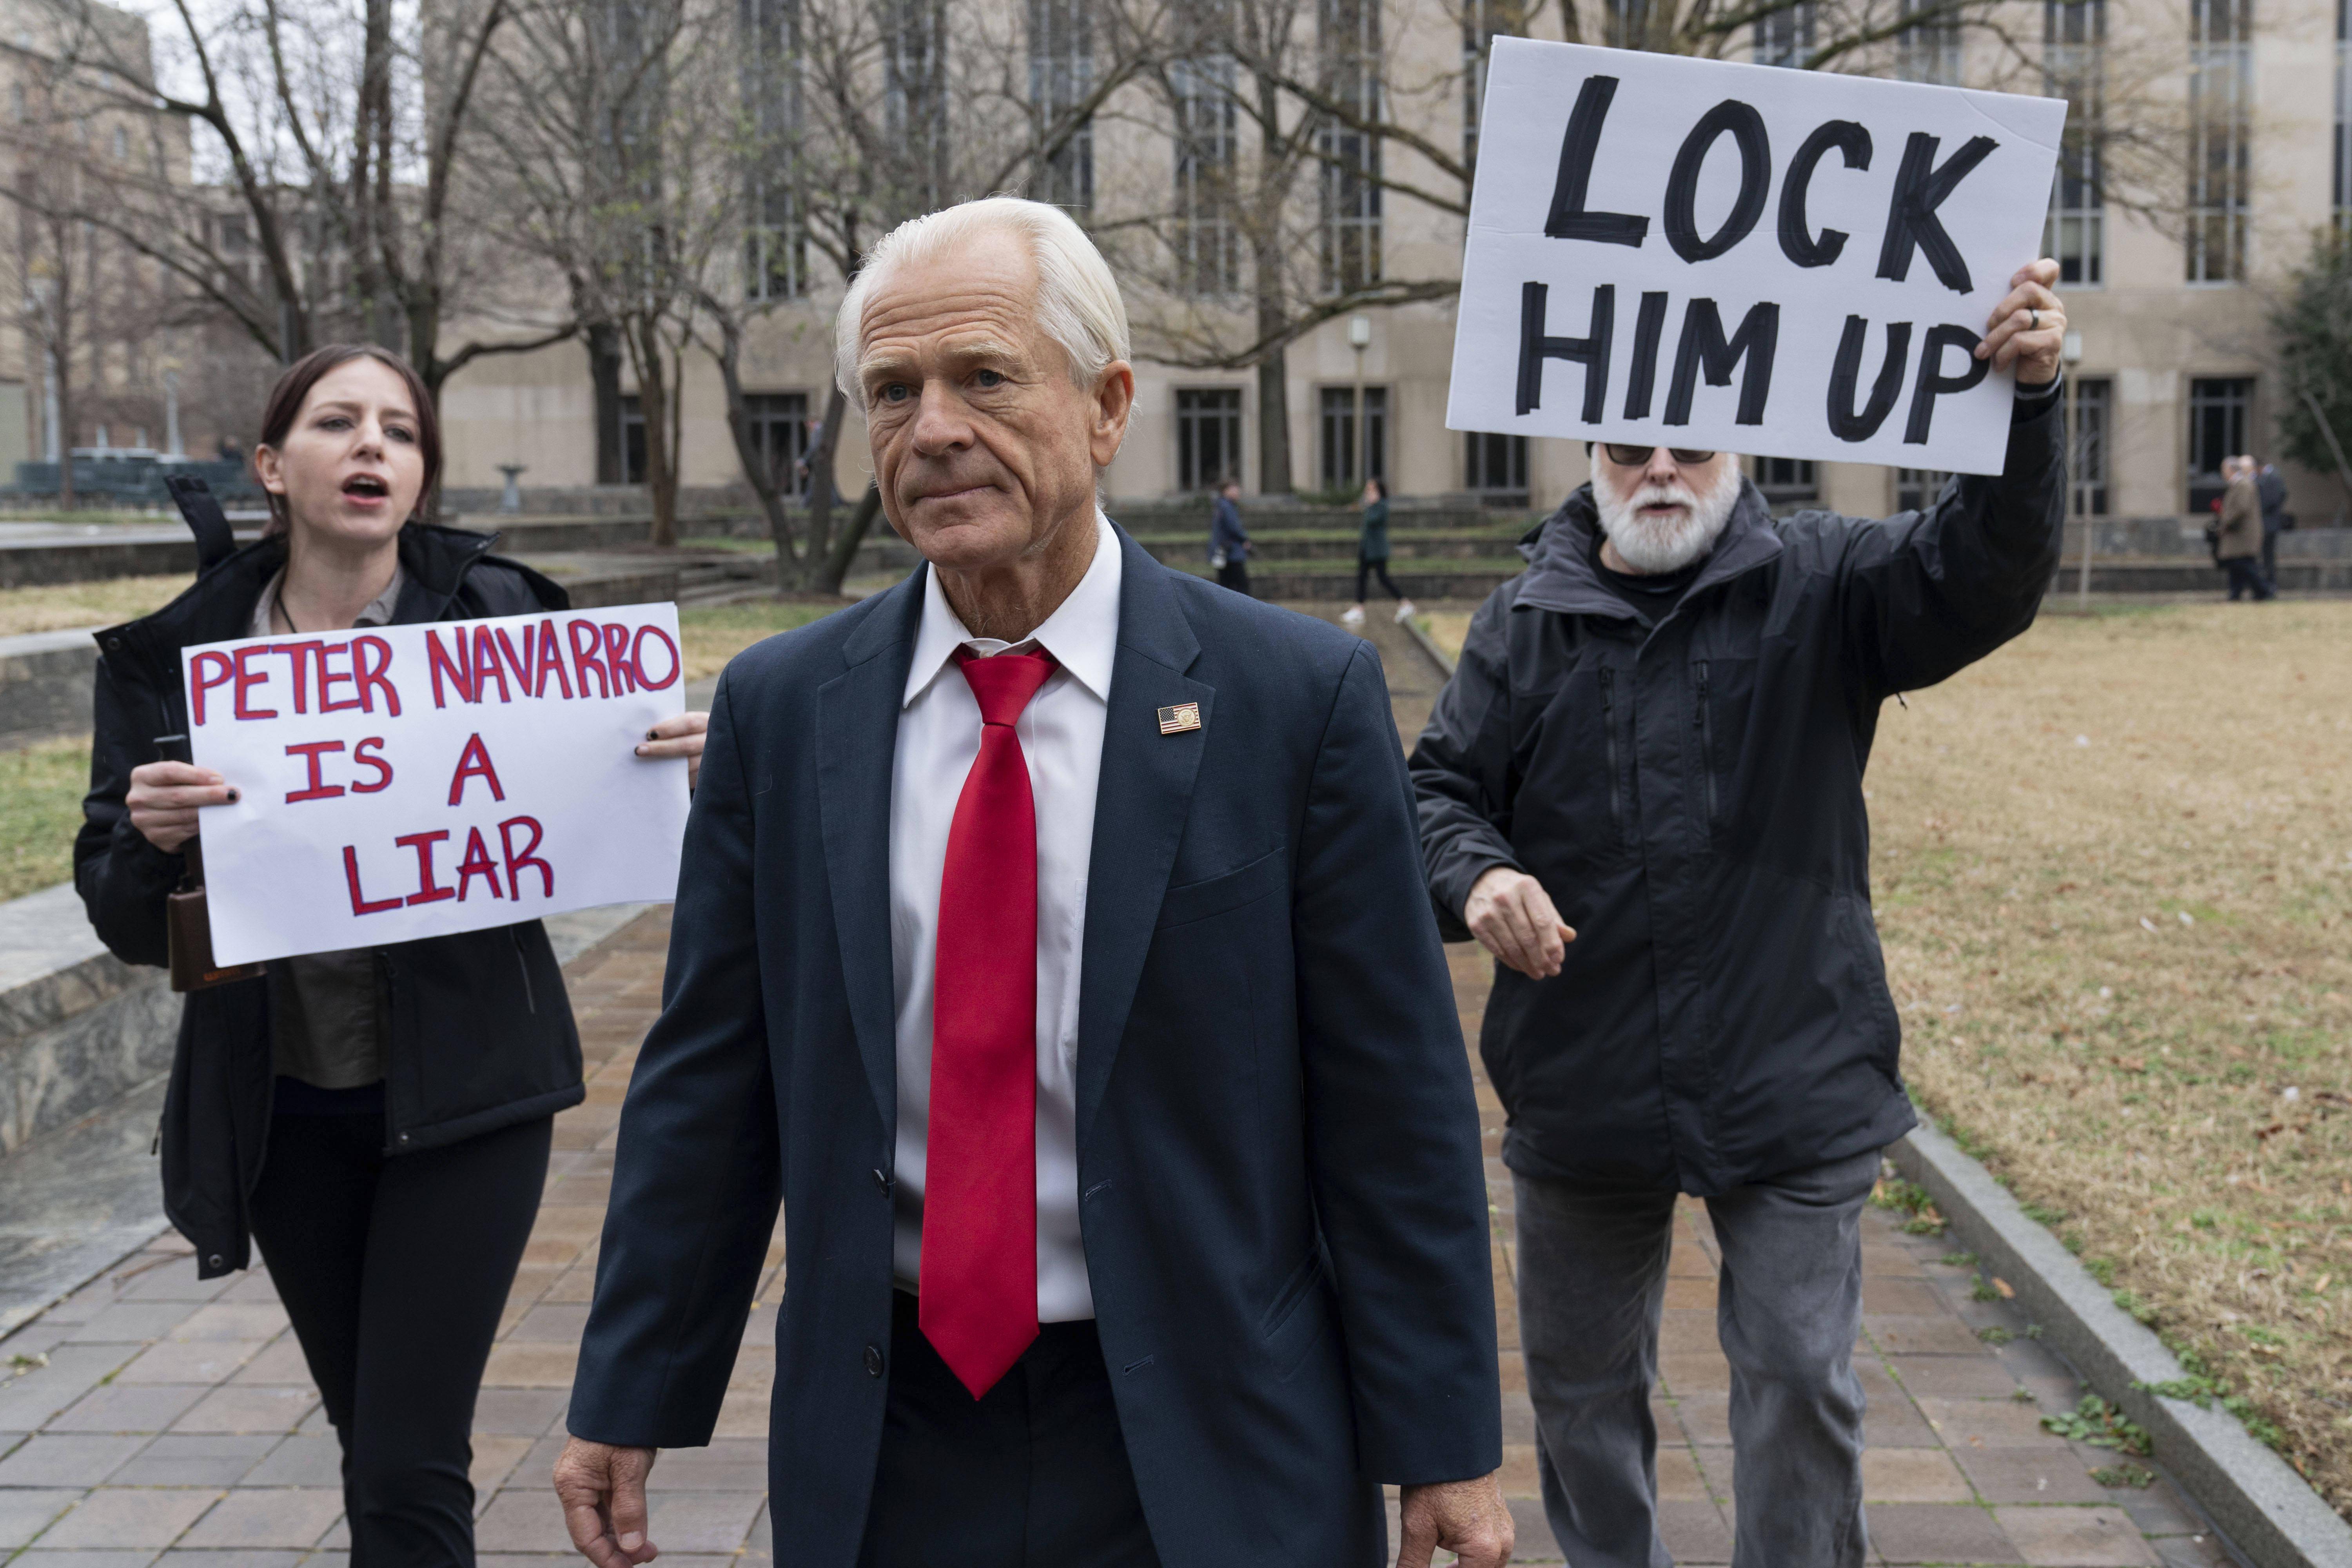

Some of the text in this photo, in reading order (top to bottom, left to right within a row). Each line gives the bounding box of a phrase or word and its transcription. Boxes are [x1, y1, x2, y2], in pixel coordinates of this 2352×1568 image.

[1544, 75, 2000, 295] LOCK
[1516, 281, 1991, 445] HIM UP
[191, 620, 679, 725] PETER NAVARRO
[286, 734, 505, 806] IS A
[344, 817, 553, 916] LIAR
